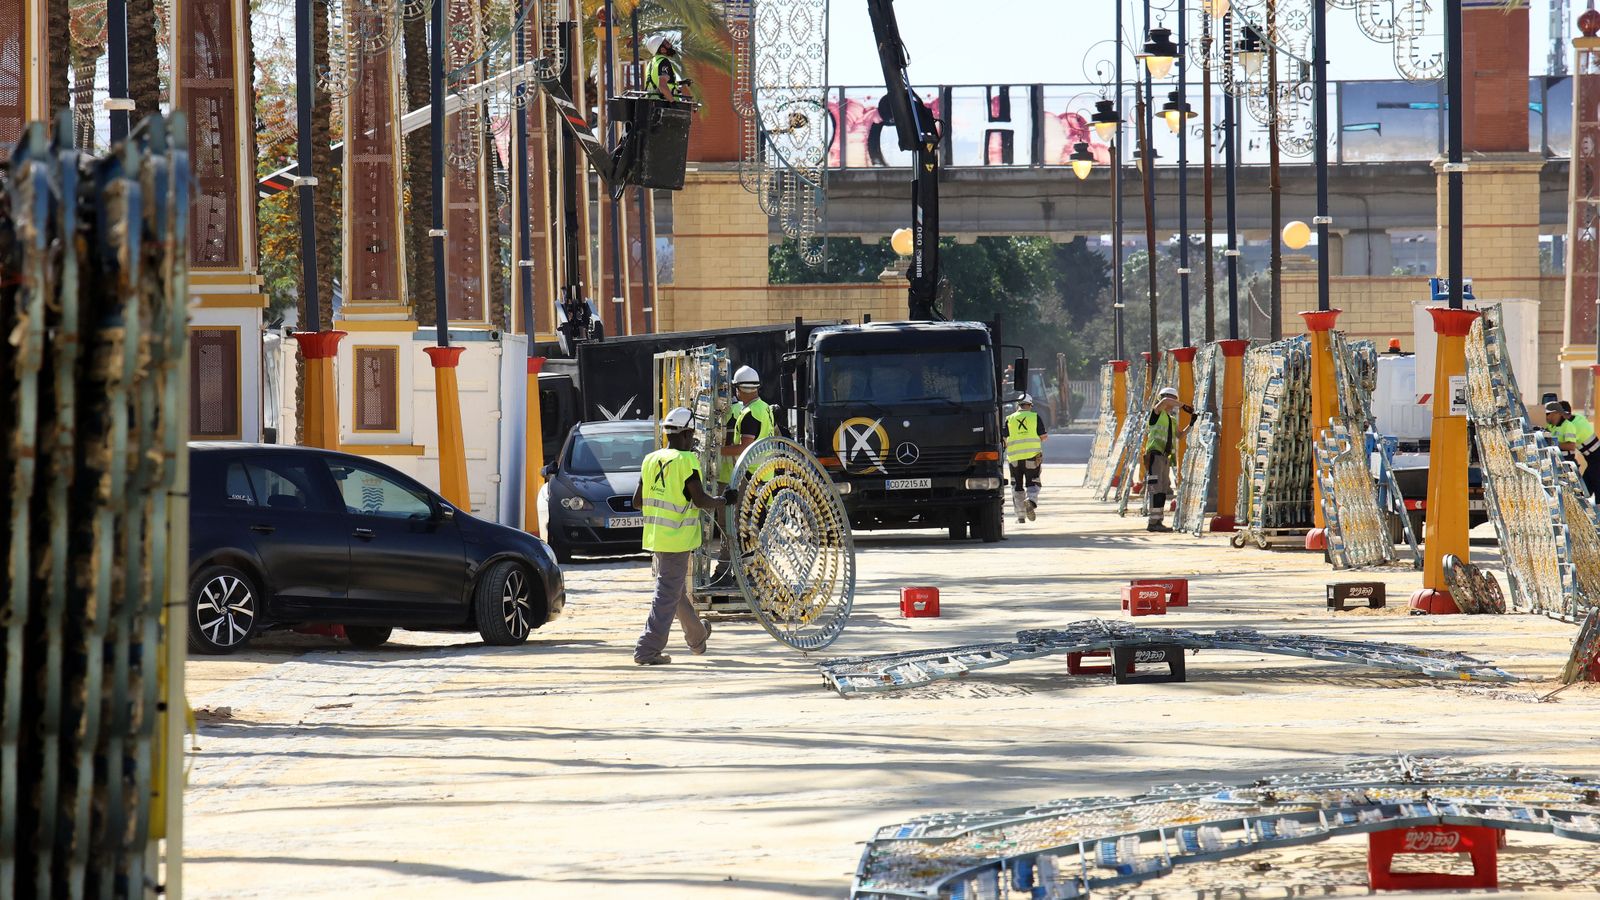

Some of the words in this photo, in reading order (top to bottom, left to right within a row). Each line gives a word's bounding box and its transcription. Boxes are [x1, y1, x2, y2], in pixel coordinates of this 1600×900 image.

[900, 479, 918, 488] 7215
[919, 479, 928, 488] AX
[610, 518, 632, 527] 2735
